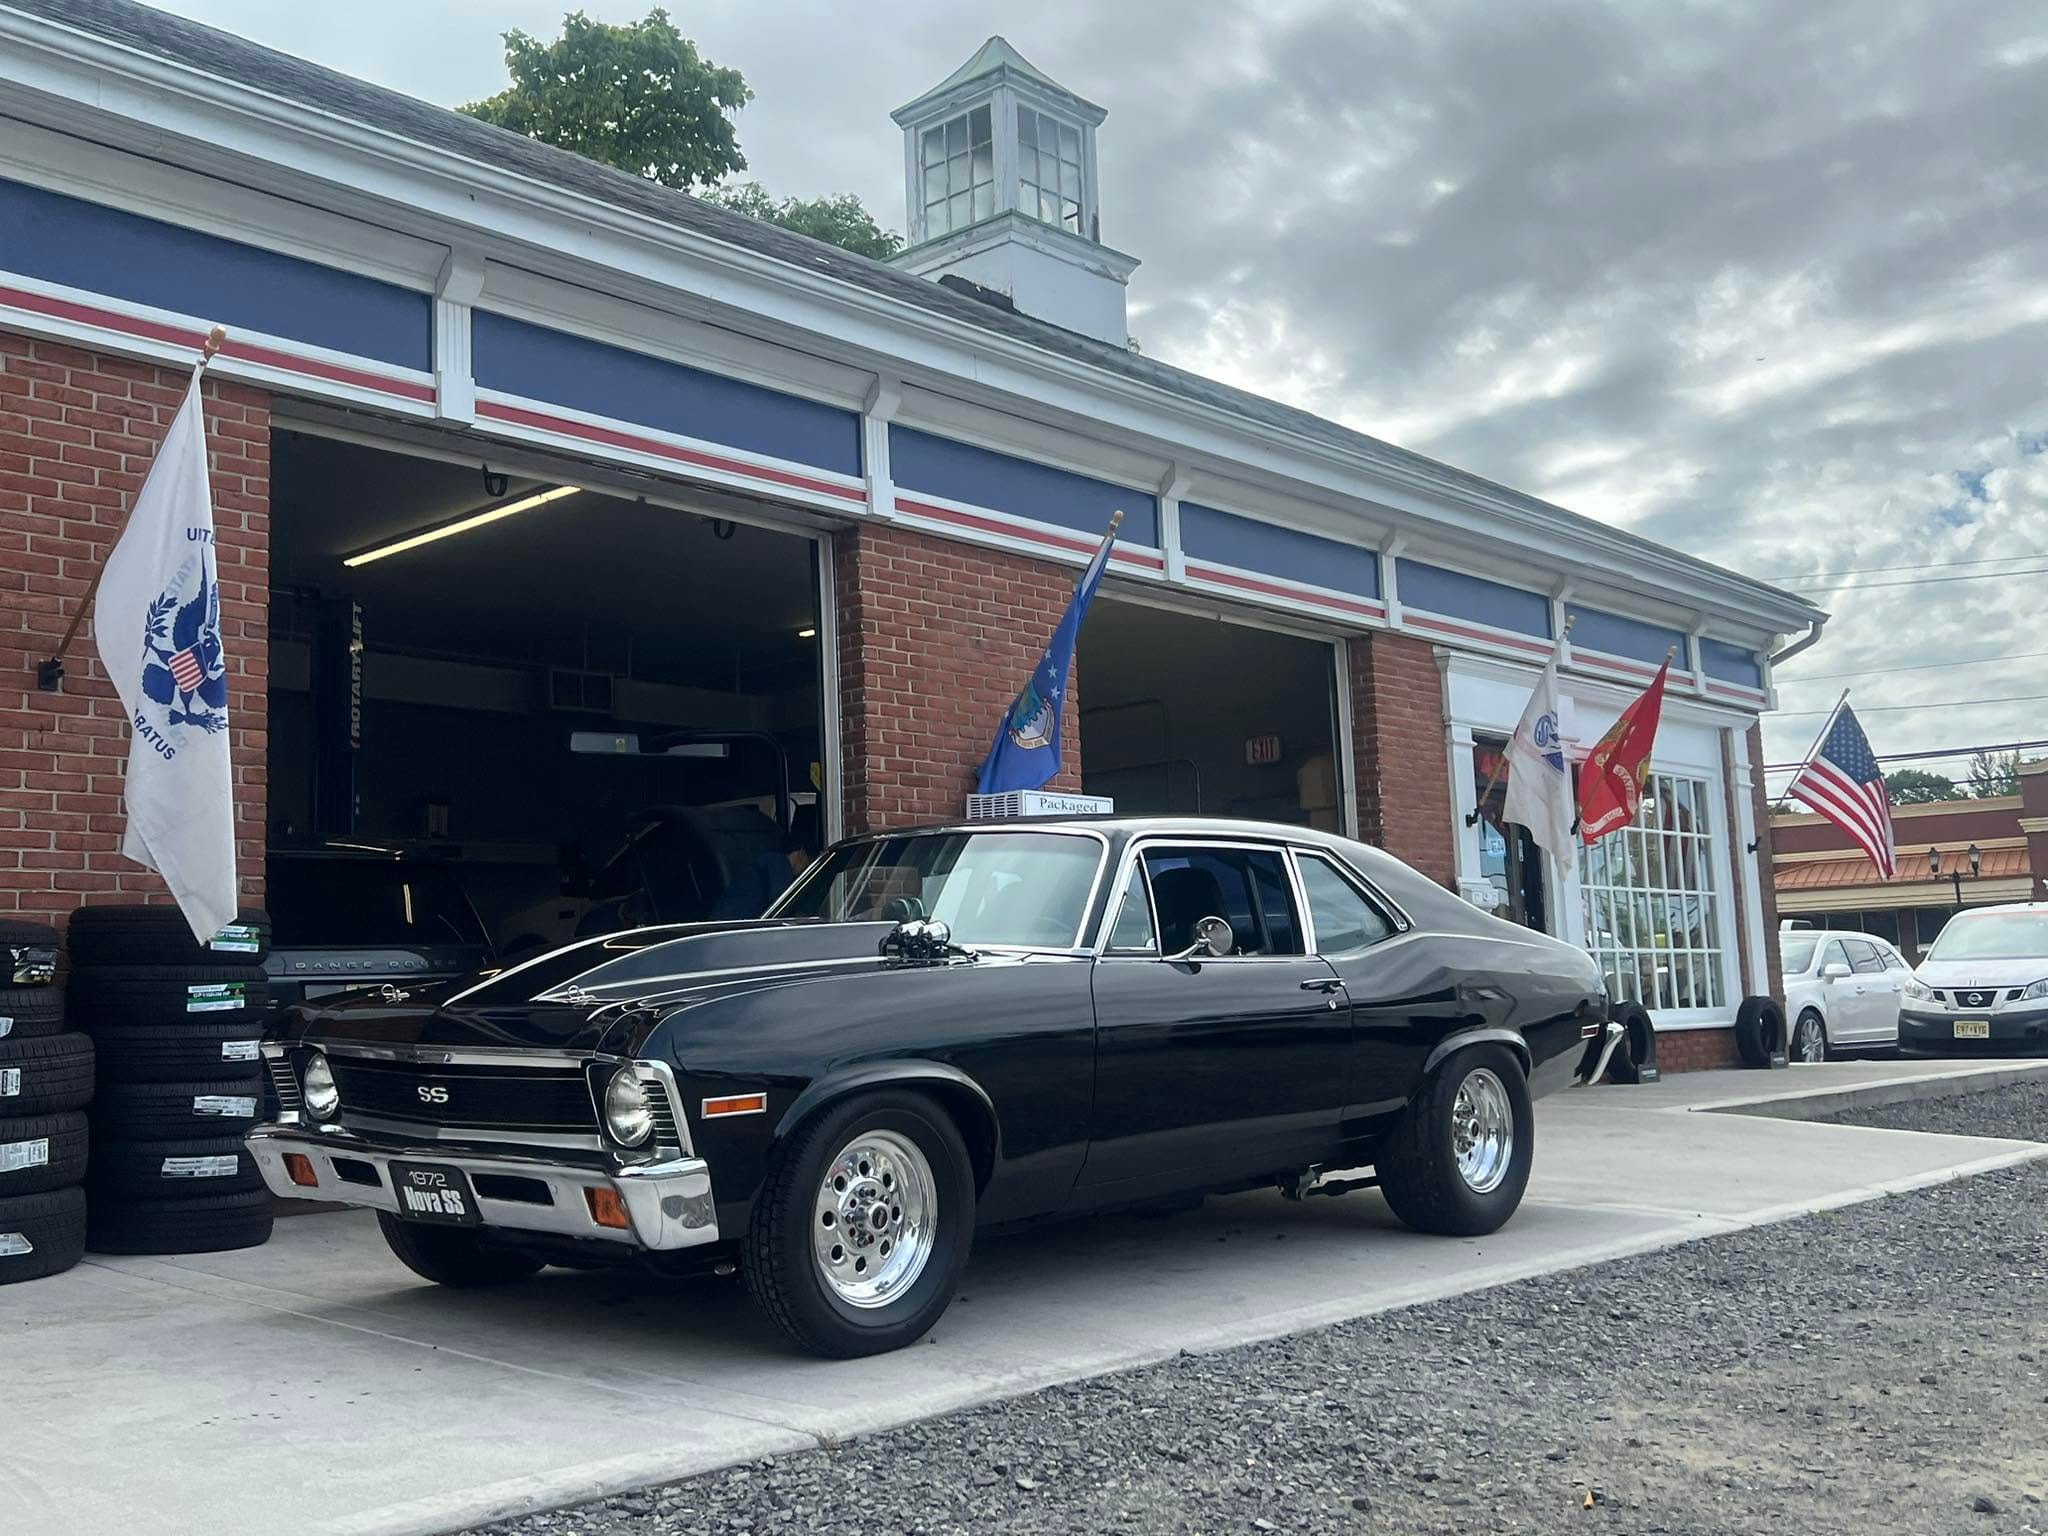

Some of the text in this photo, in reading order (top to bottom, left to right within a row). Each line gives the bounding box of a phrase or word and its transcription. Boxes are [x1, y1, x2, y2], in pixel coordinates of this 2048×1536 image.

[351, 653, 362, 737] ROTARY
[1251, 736, 1274, 761] EXIT
[1040, 797, 1098, 814] Packaged
[295, 960, 374, 970] RANGE
[417, 1086, 449, 1103] SS
[409, 1171, 447, 1187] 1972
[403, 1185, 466, 1215] Nova SS
